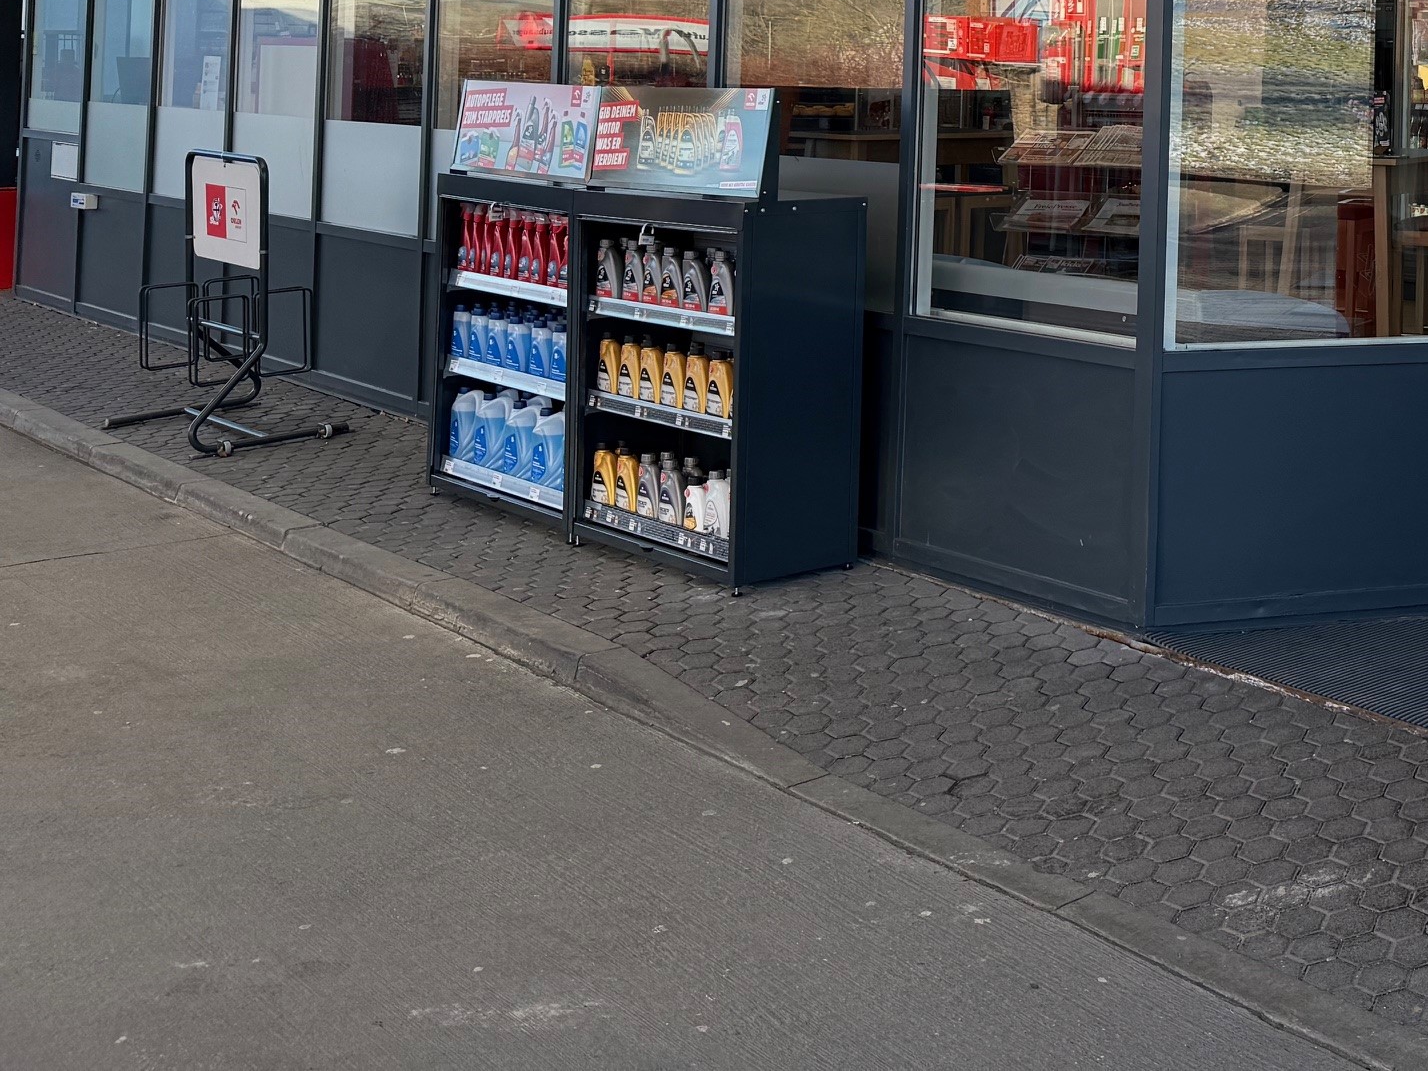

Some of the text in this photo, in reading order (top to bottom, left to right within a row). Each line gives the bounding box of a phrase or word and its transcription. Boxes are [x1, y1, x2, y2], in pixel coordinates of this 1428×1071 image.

[465, 92, 505, 108] AUTOPFLEGE
[463, 109, 511, 125] ZUM STARPREIS
[599, 104, 637, 120] GIB DEINEM
[597, 121, 621, 134] MOTOR
[596, 137, 622, 150] WAS ER
[594, 152, 628, 166] VERDIENT
